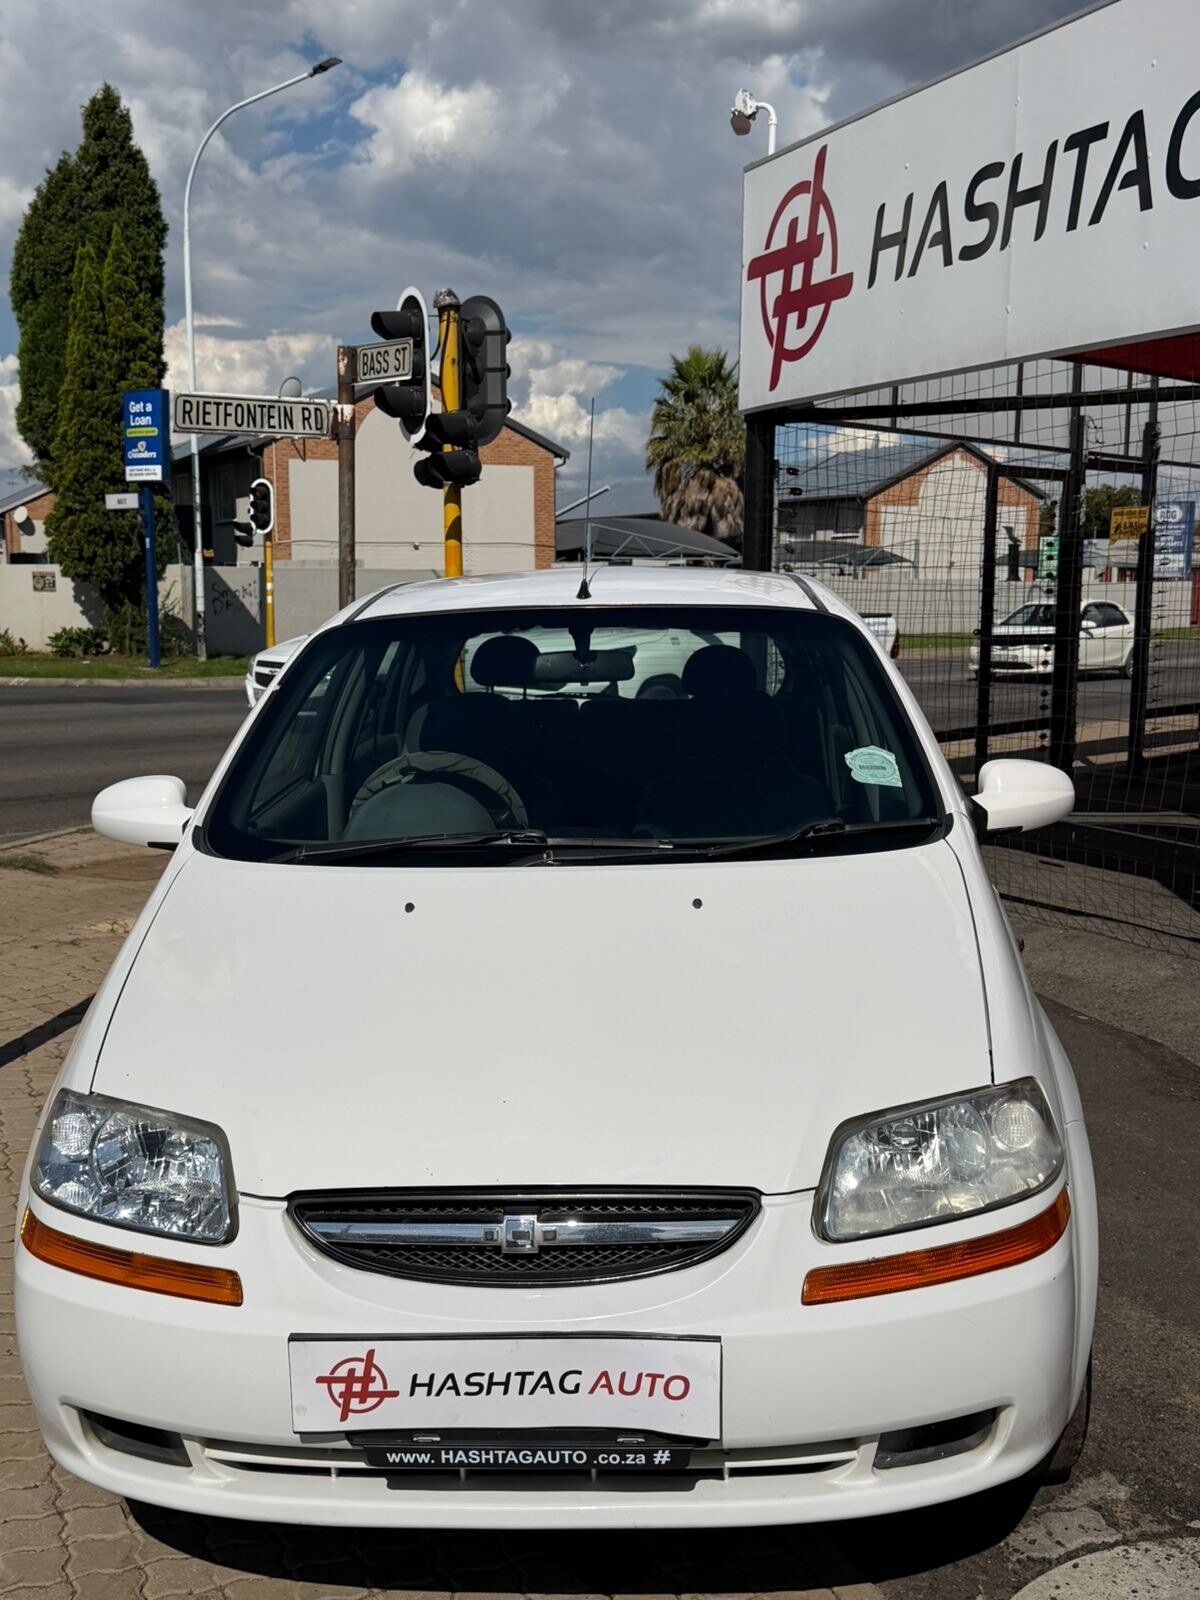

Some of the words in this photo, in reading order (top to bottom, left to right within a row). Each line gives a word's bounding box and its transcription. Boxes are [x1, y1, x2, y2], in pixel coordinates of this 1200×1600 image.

[362, 350, 389, 376] BASS
[394, 347, 408, 372] ST
[129, 401, 144, 413] Get
[145, 402, 152, 412] a
[182, 400, 295, 430] RIETFONTEIN
[302, 405, 324, 432] RD
[130, 414, 152, 426] Loan
[409, 1369, 583, 1397] HASHTAG
[588, 1369, 690, 1401] AUTO
[386, 1452, 435, 1464] www.
[441, 1450, 587, 1464] HASHTAGAUTO
[593, 1453, 646, 1464] .co.za
